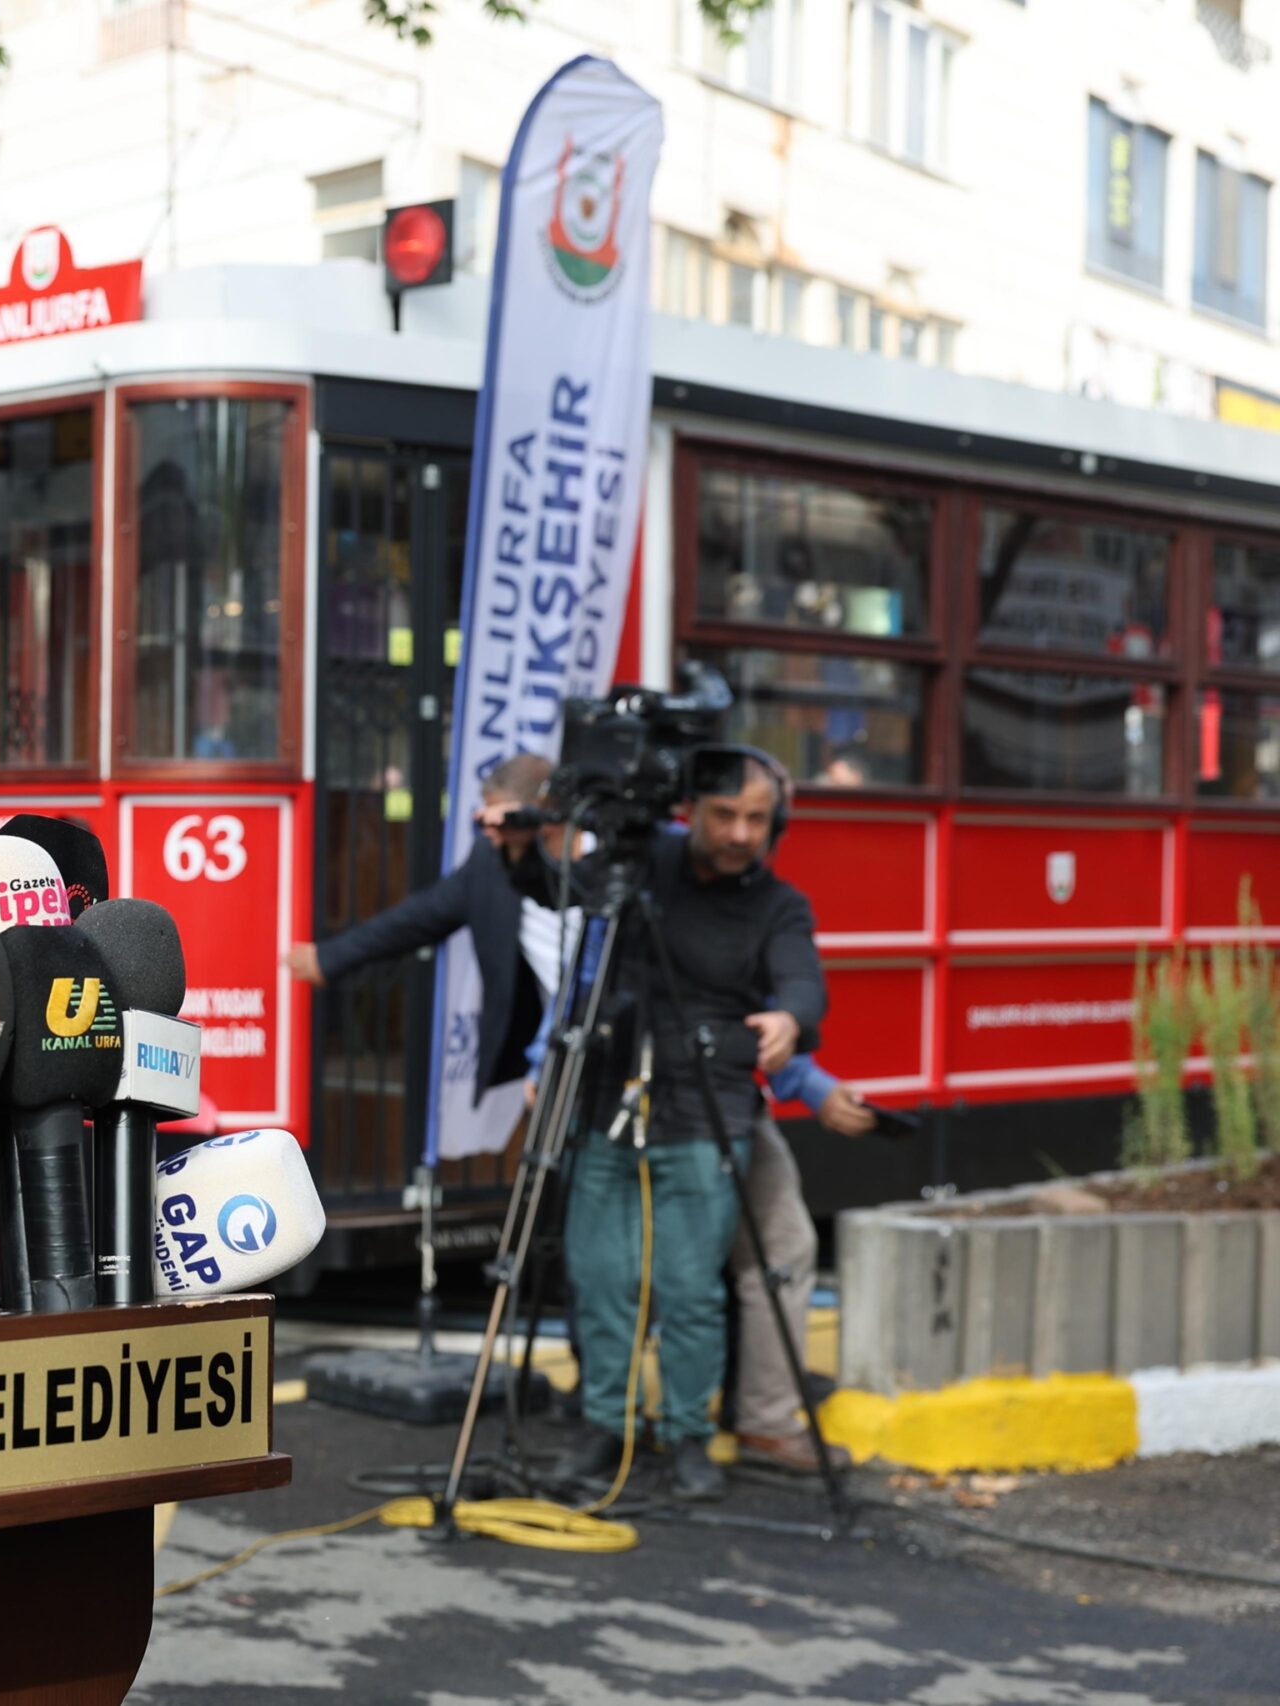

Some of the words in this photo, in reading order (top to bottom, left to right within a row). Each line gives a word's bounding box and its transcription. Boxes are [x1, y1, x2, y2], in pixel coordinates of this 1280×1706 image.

[163, 814, 248, 882] 63
[9, 876, 56, 891] Gazete
[41, 1036, 92, 1051] KANAL
[95, 1035, 121, 1048] URFA
[161, 1193, 222, 1285] GAP
